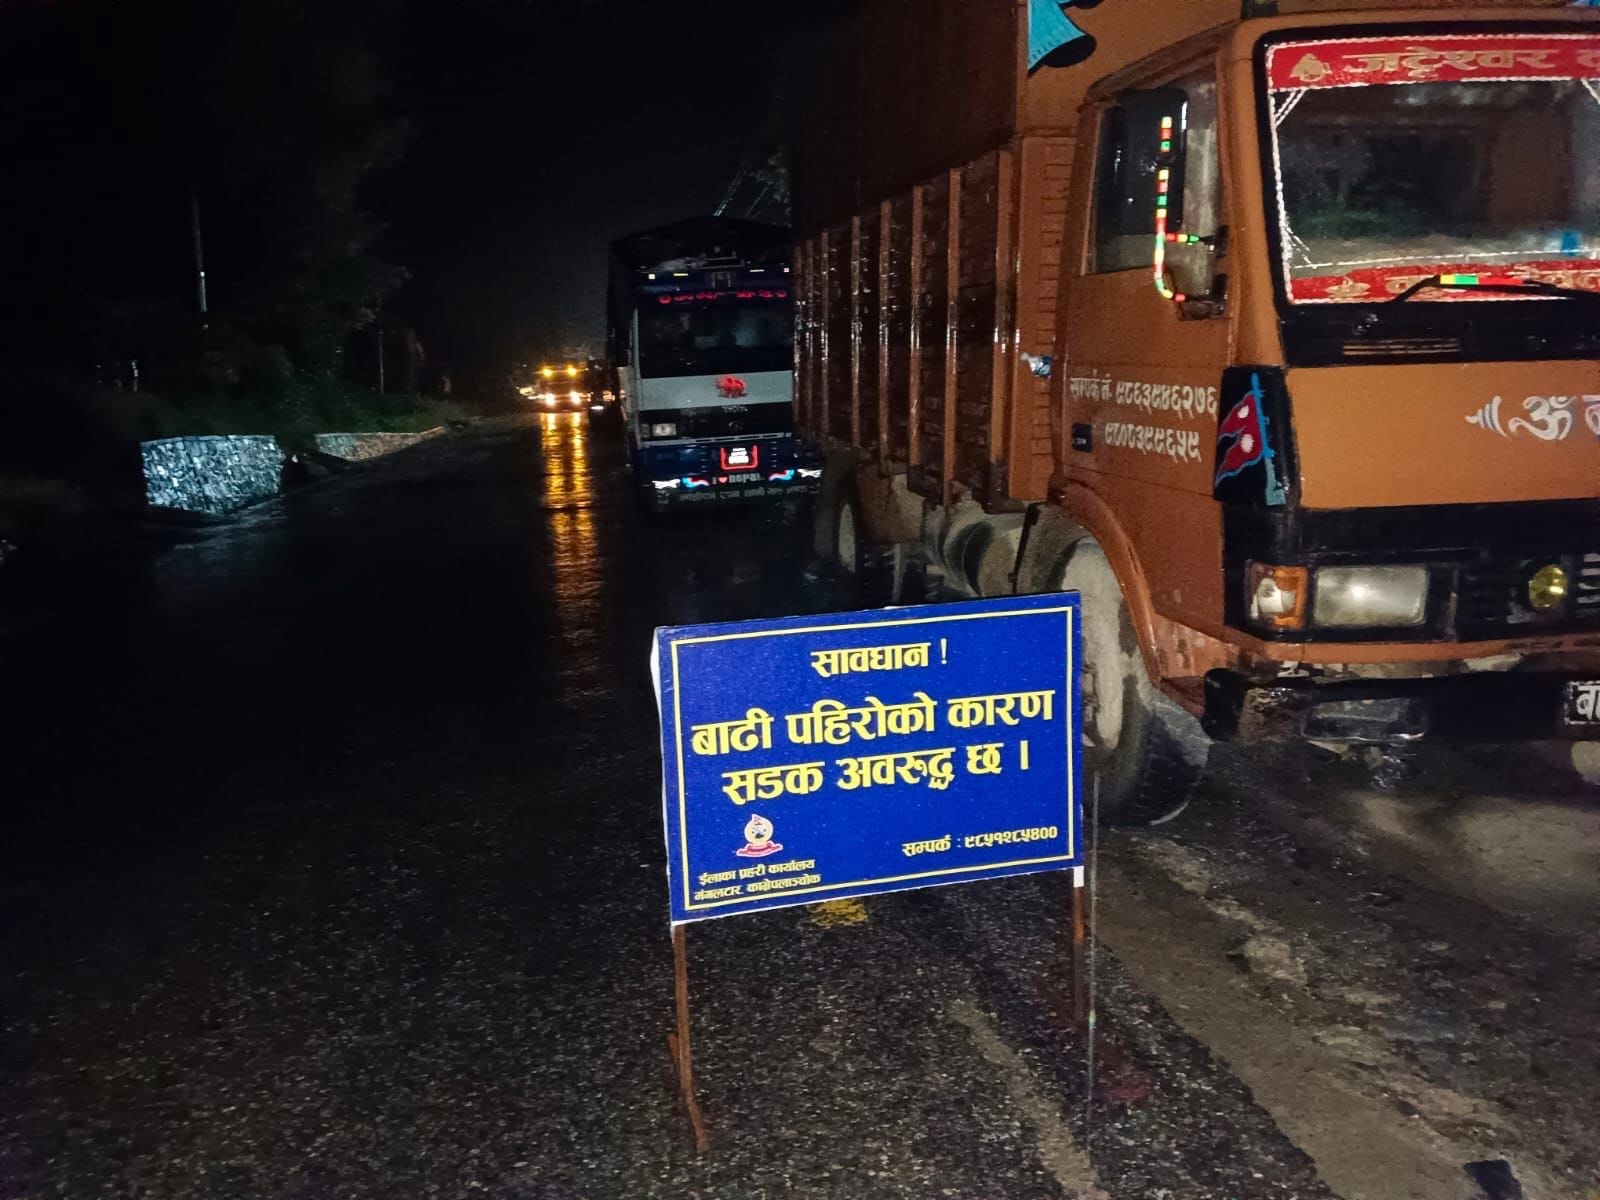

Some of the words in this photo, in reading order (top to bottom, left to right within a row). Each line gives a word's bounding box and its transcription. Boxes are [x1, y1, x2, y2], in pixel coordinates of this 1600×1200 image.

[691, 707, 775, 755] बाढी
[785, 692, 938, 745] पहिरोको
[947, 690, 1056, 727] कारण
[721, 761, 826, 806] सडक
[966, 742, 1005, 775] छ
[902, 834, 952, 857] सम्पर्क
[964, 826, 1058, 849] ९८५१२८५४००
